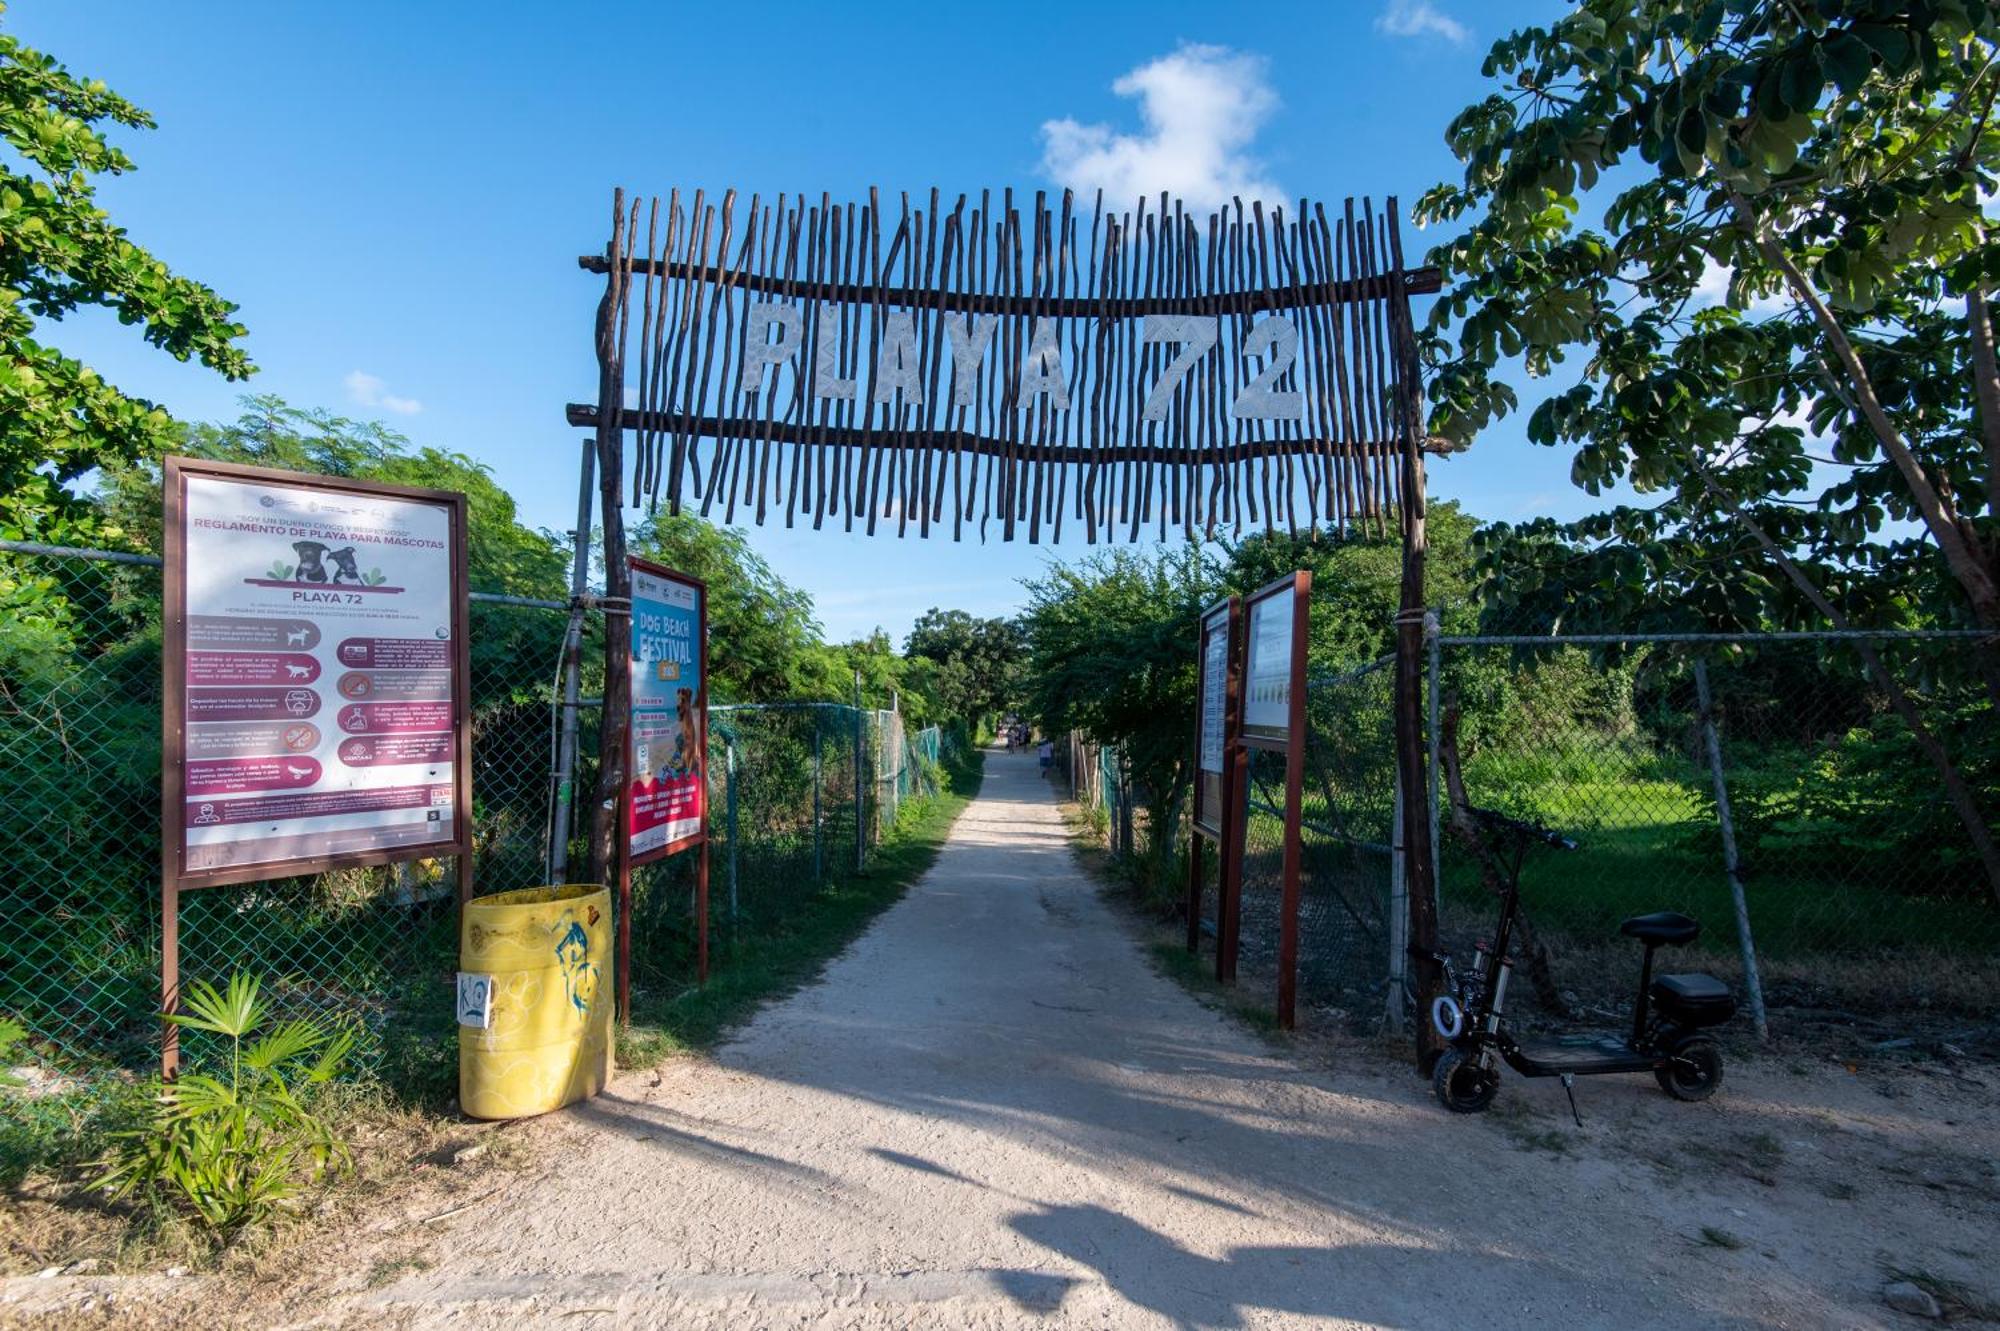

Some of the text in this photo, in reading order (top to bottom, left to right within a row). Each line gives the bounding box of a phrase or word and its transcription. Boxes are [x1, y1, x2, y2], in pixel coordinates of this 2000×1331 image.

[742, 303, 1303, 421] PLAYA 72
[193, 518, 445, 550] REGLAMENTO DE PLAYA PARA MASCOTAS
[292, 591, 363, 605] PLAYA 72
[640, 612, 690, 638] DOG BEACH
[640, 633, 692, 665] FESTIVAL
